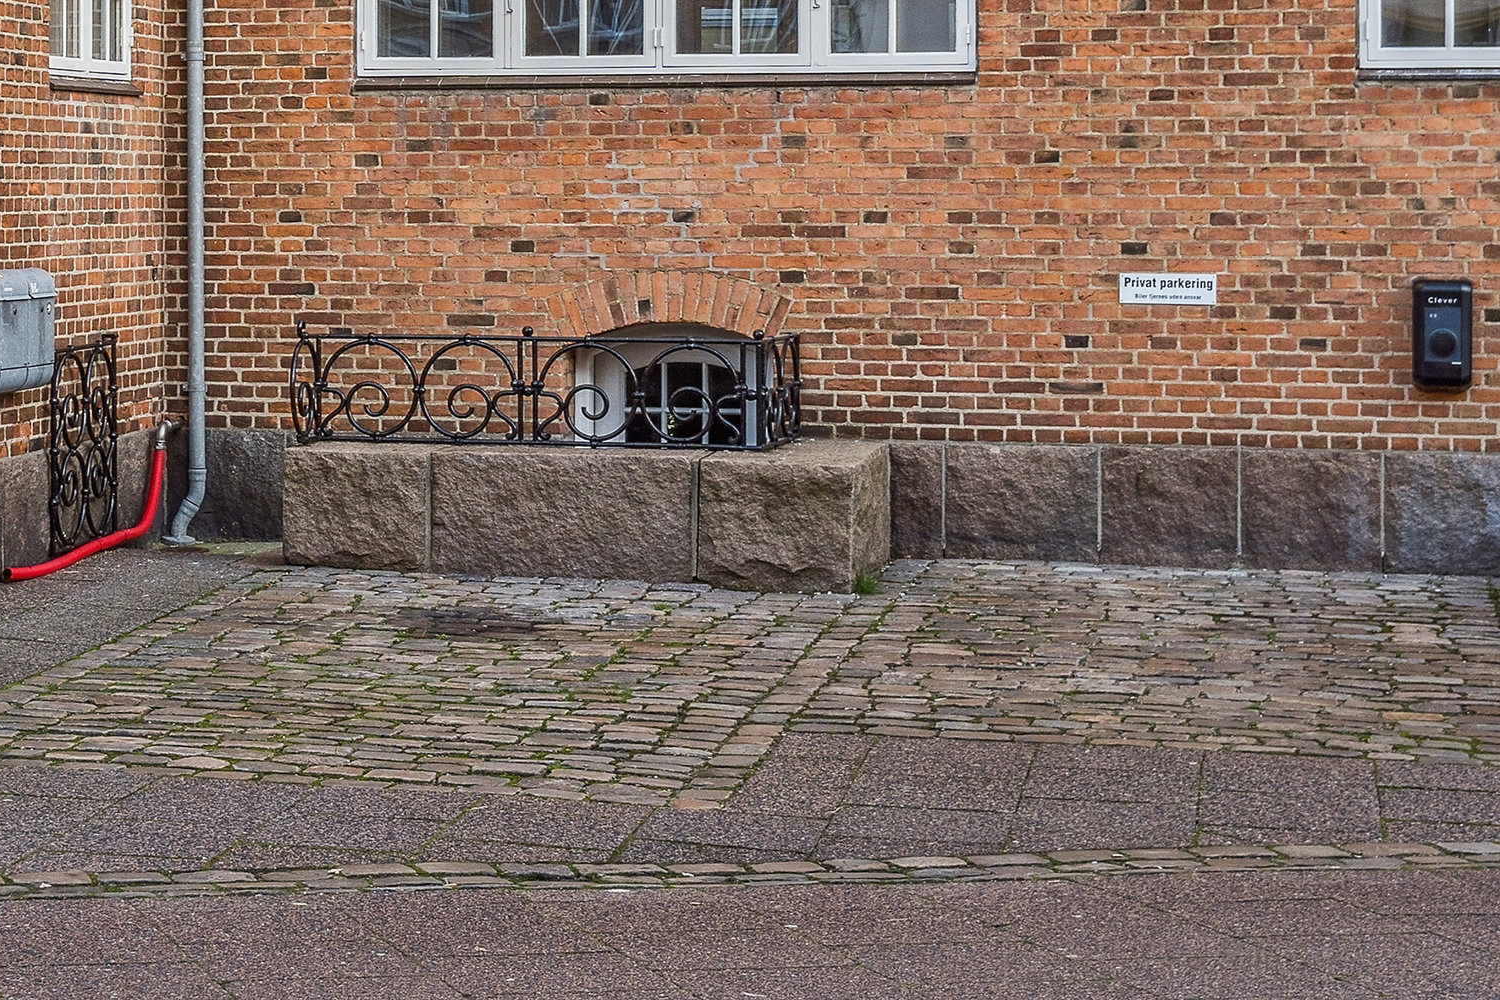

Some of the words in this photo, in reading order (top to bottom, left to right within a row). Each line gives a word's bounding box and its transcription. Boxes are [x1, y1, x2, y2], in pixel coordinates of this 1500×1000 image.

[1124, 277, 1157, 288] Privat
[1160, 278, 1213, 292] parkering
[1428, 296, 1458, 304] Clever
